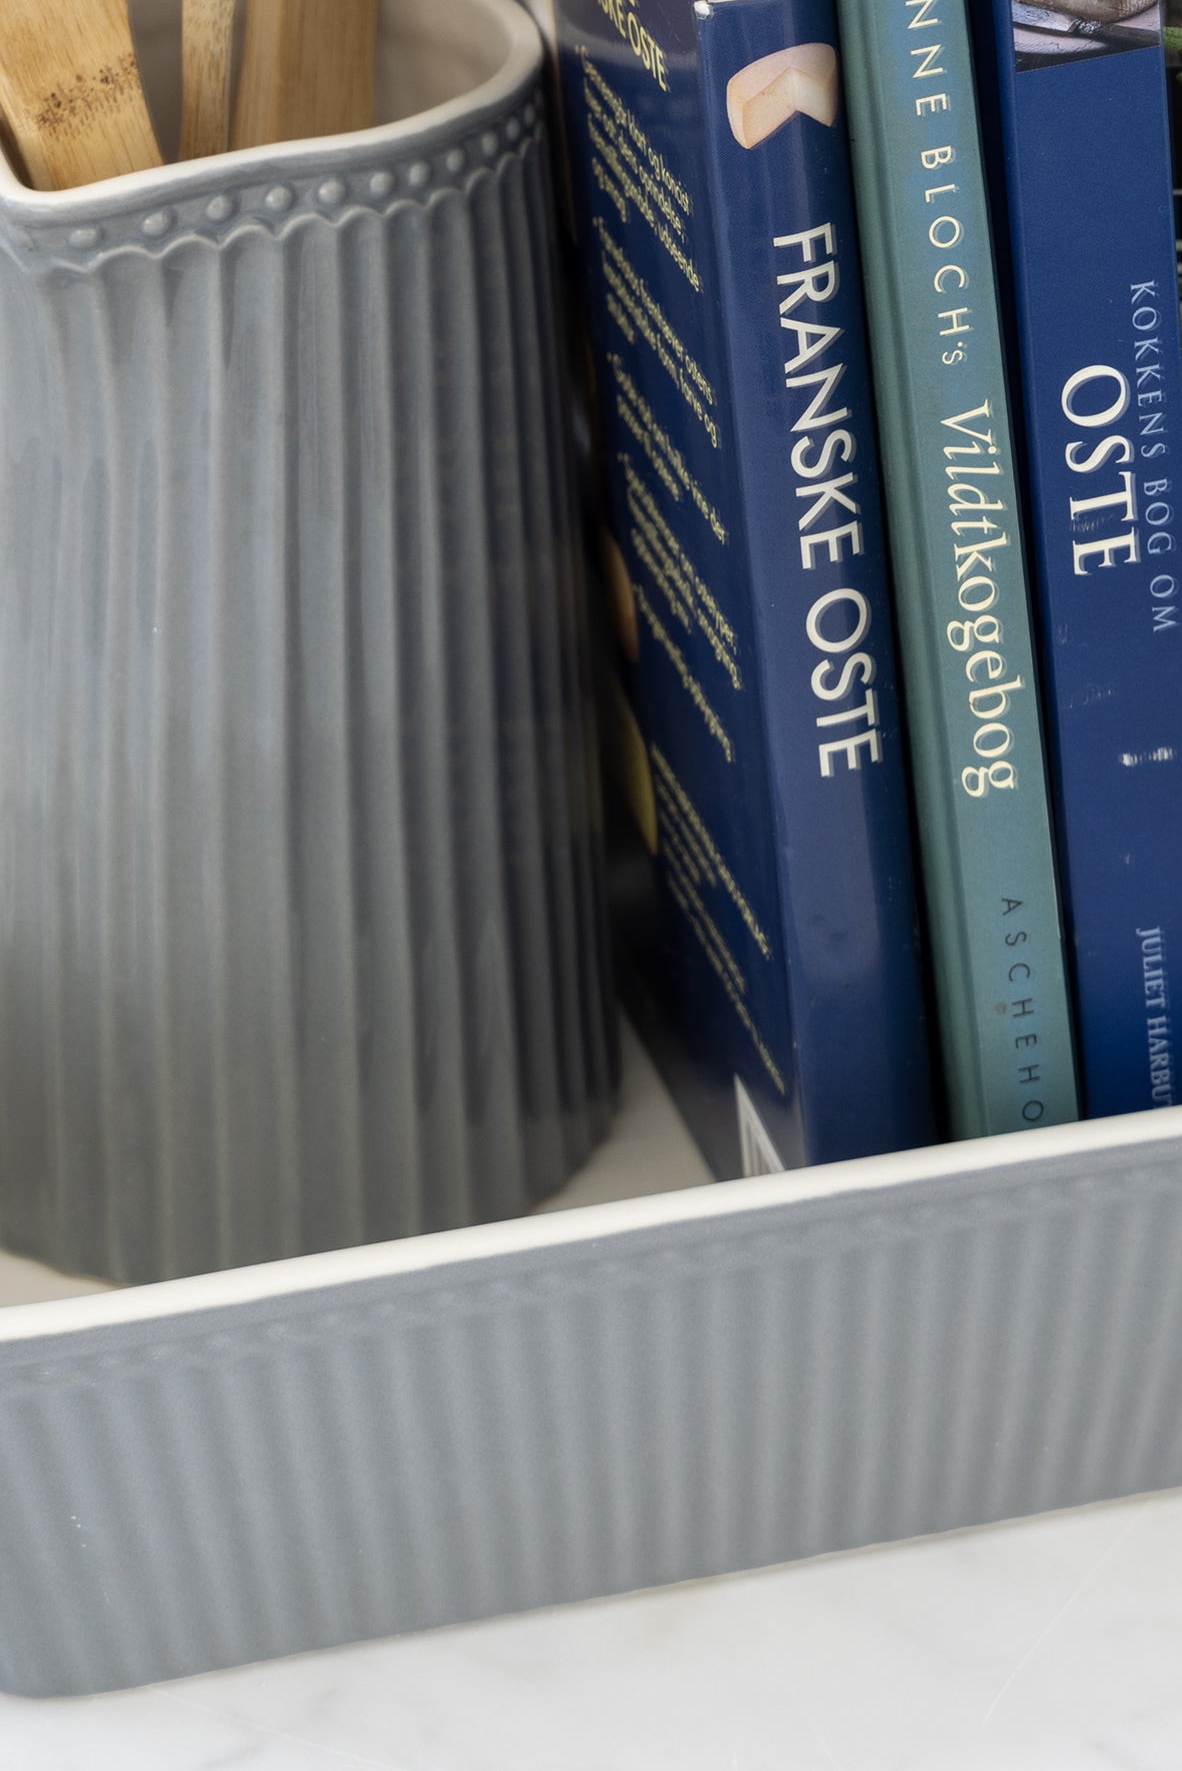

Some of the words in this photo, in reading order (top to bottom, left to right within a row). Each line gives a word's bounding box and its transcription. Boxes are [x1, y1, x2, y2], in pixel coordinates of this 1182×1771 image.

[627, 11, 668, 93] OSTE
[627, 109, 647, 156] klart
[648, 147, 661, 182] og
[659, 153, 691, 216] koncist
[657, 221, 700, 293] udseende
[679, 367, 703, 421] farve
[703, 413, 718, 449] og
[685, 355, 714, 406] ostens
[772, 221, 862, 570] FRANSKE
[1130, 280, 1168, 458] KOKKENS
[1061, 364, 1139, 576] OSTE
[709, 506, 726, 546] der
[1143, 477, 1174, 555] BOG
[940, 398, 1026, 798] Vildtkogebog
[1150, 573, 1178, 632] OM
[805, 586, 881, 779] OSTE
[1136, 926, 1166, 1008] JULIET
[1001, 896, 1045, 1122] ASCHEHO
